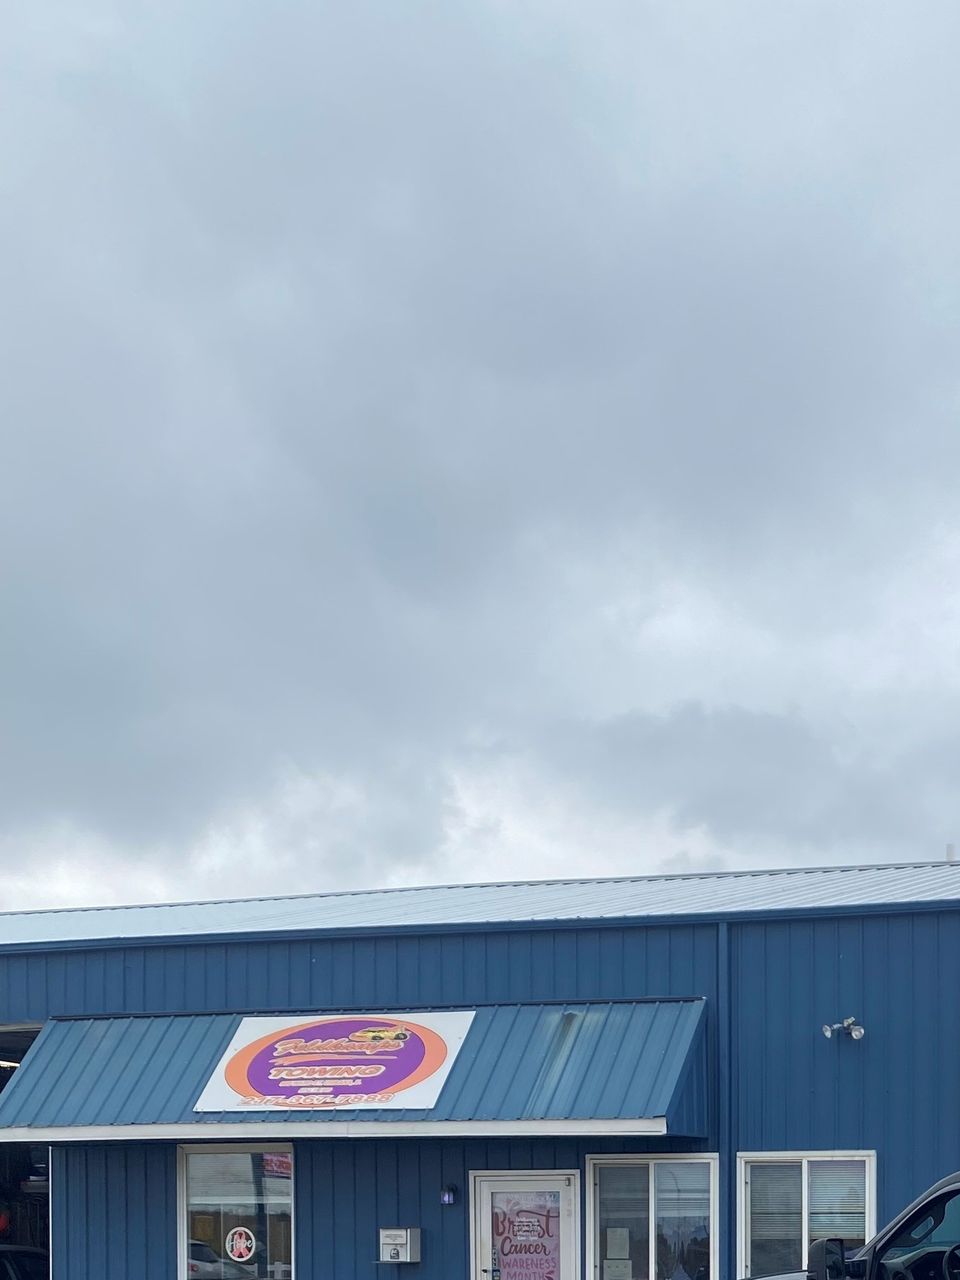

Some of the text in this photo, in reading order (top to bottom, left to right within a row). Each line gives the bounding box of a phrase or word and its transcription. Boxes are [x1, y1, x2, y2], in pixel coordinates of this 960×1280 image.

[269, 1065, 386, 1079] TOWING
[494, 1207, 559, 1238] Brst
[501, 1236, 551, 1256] Cancer
[500, 1257, 557, 1270] WARENESS
[506, 1271, 545, 1280] MONTH
